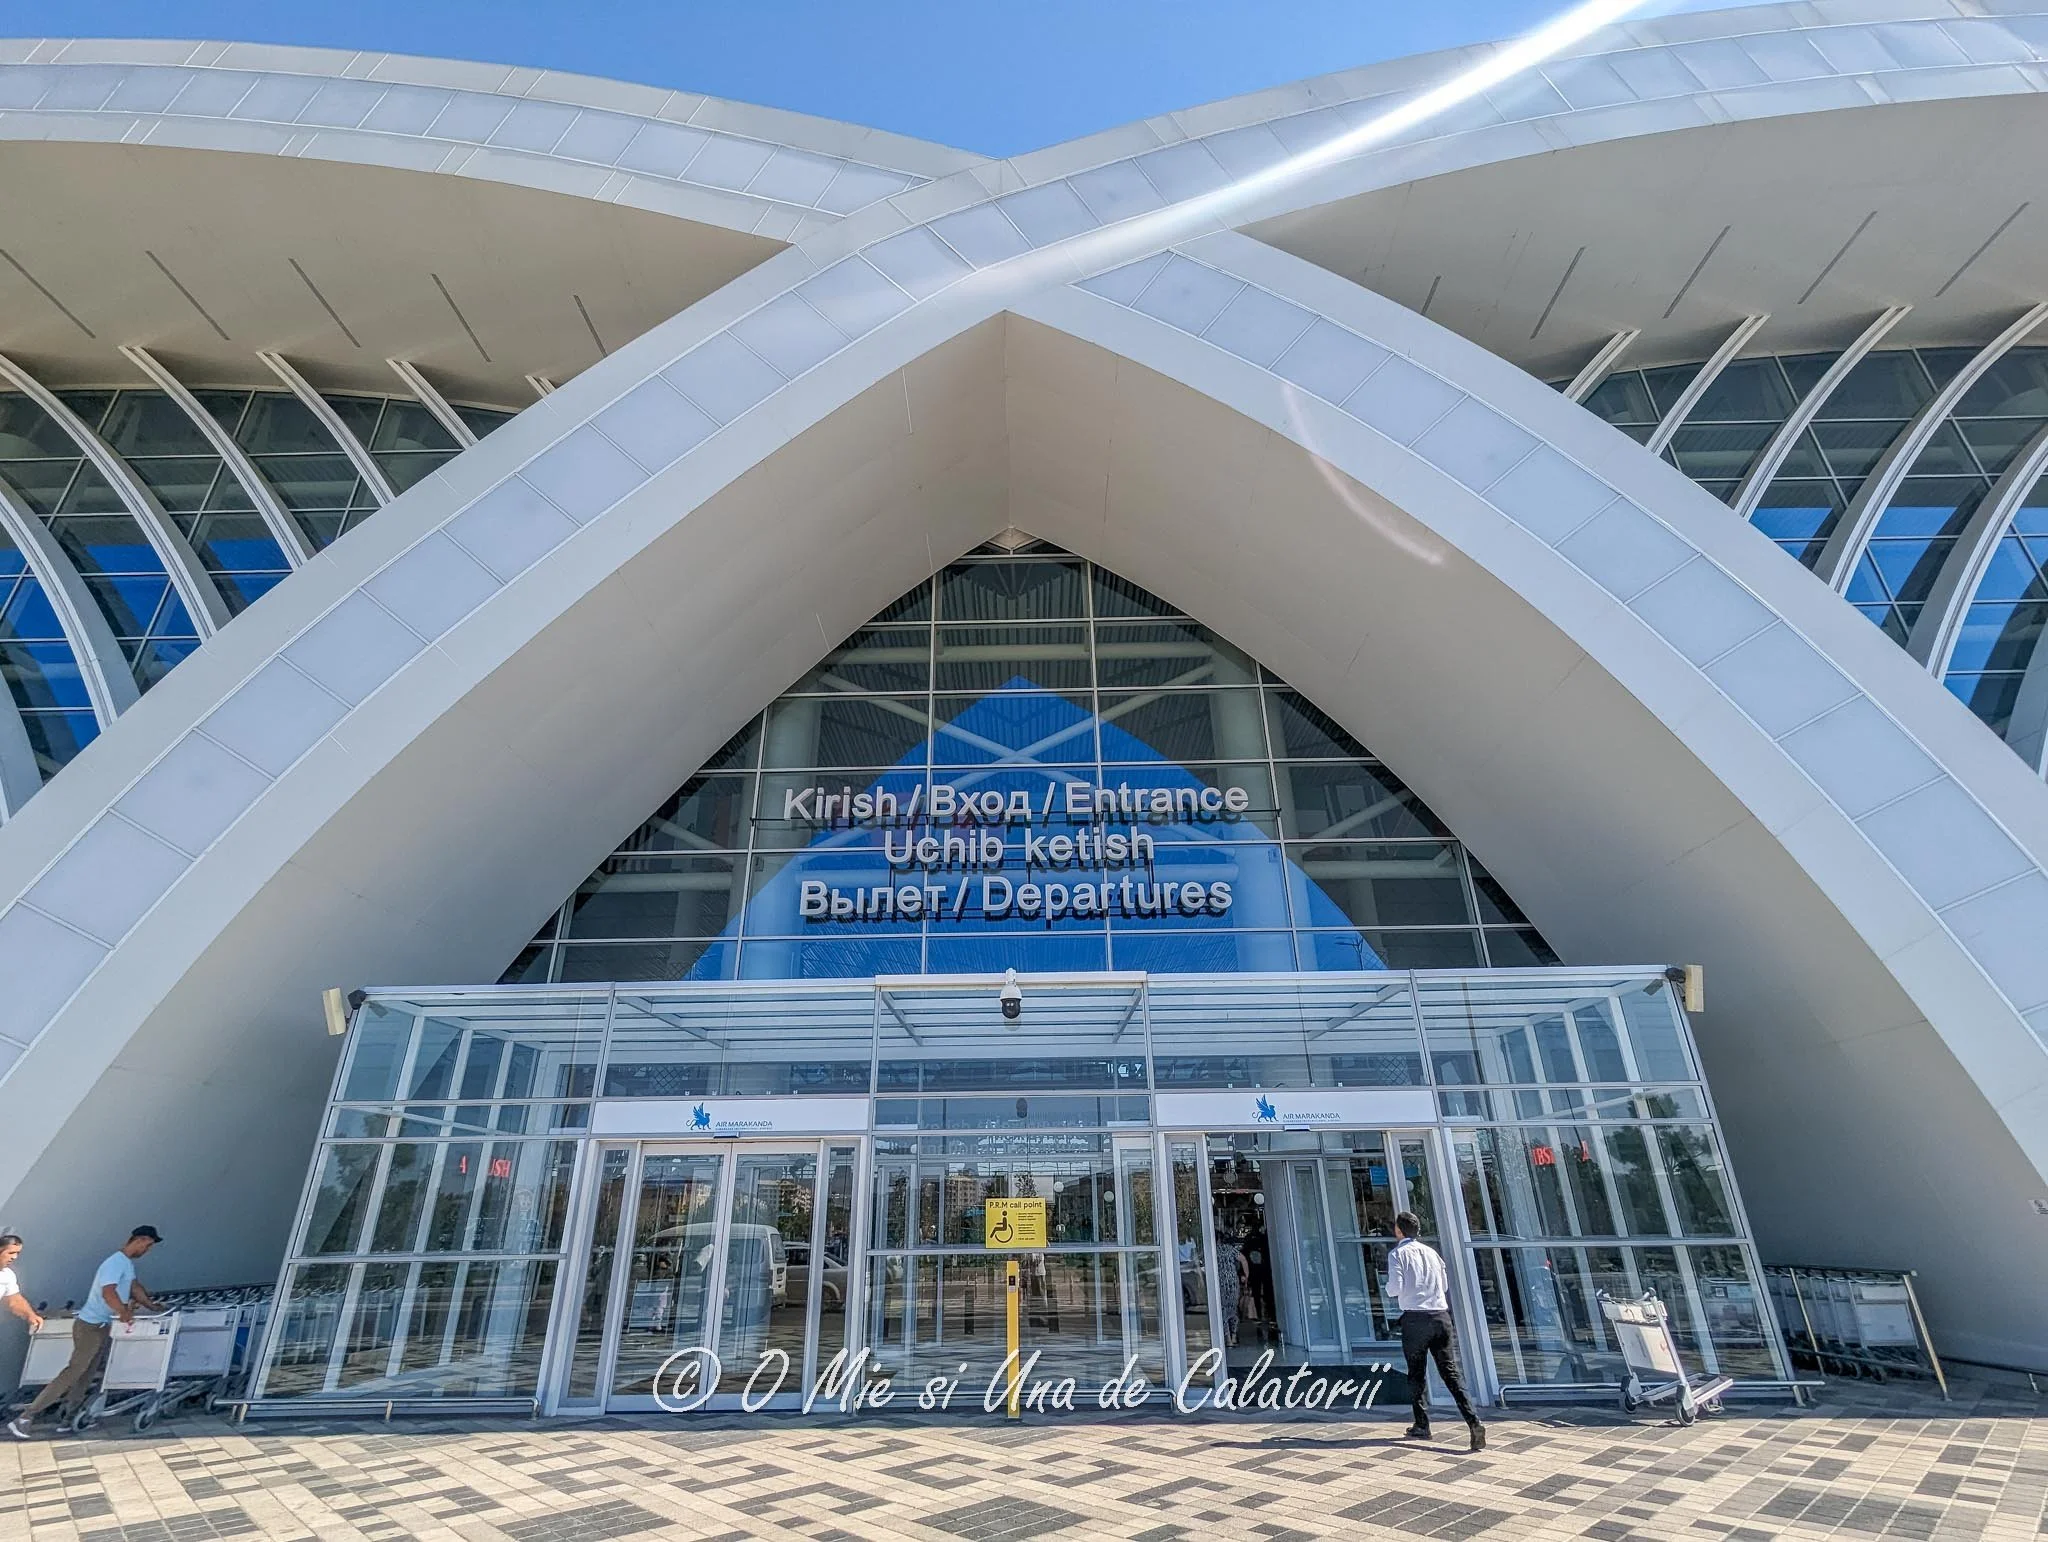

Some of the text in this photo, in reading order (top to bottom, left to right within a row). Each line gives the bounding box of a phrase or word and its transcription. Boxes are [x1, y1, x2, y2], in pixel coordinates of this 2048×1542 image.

[783, 785, 897, 820] Kirish
[930, 784, 1032, 822] Вход
[1065, 781, 1249, 814] Entrance
[885, 825, 1154, 864] Uchib ketish
[800, 880, 946, 917] Вылет
[982, 874, 1233, 920] Departures
[1009, 1201, 1022, 1209] call
[1023, 1201, 1042, 1210] point
